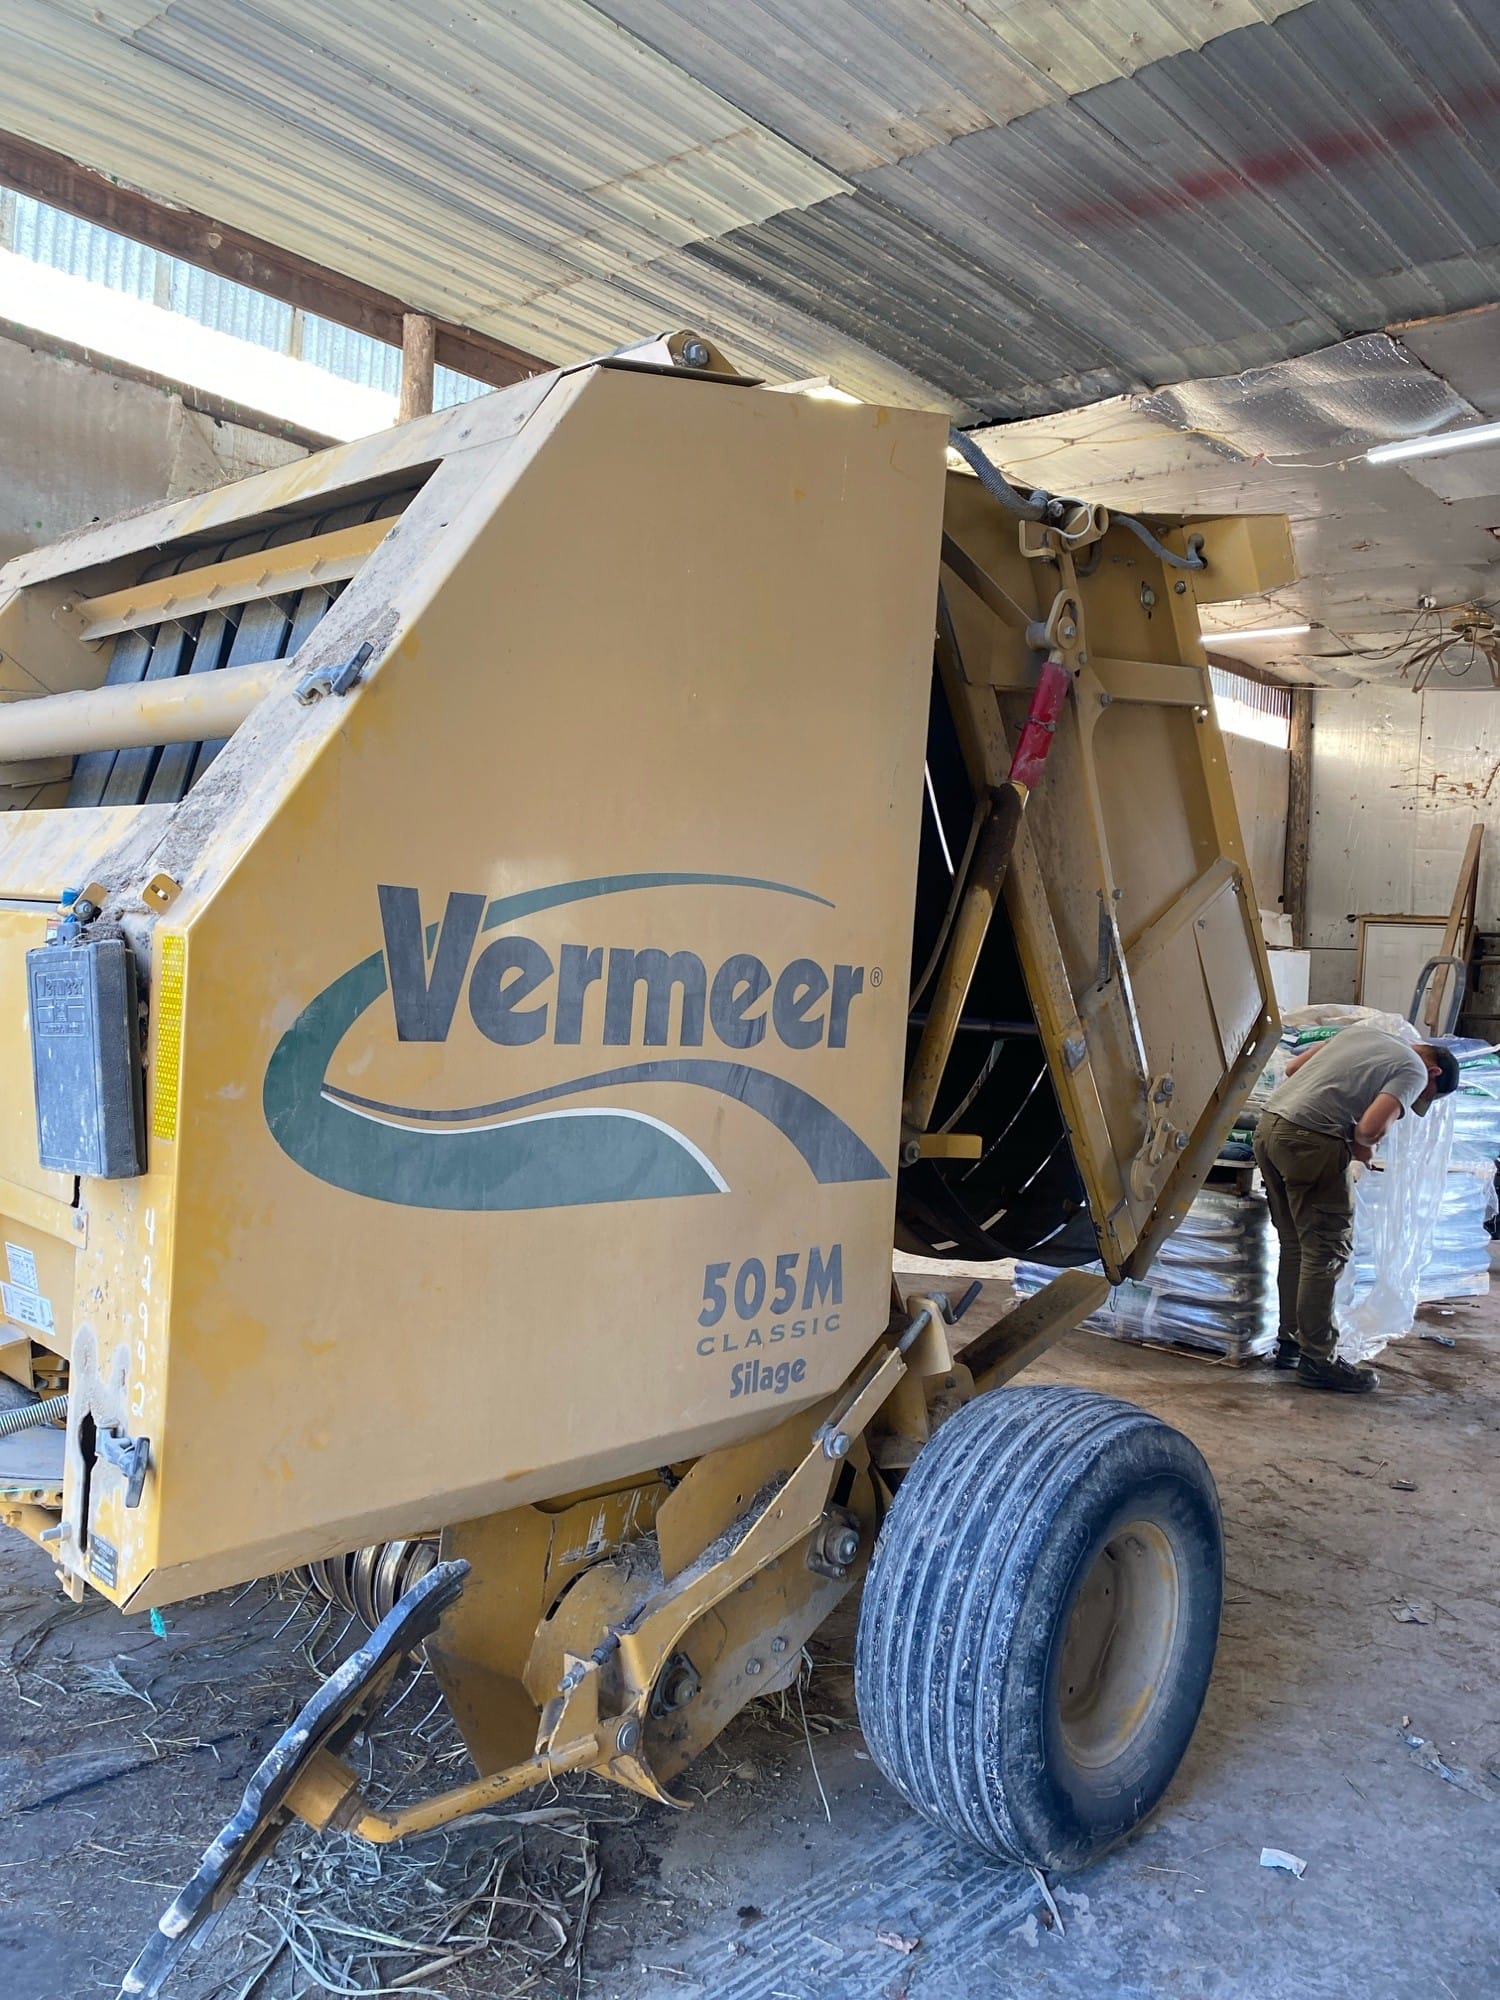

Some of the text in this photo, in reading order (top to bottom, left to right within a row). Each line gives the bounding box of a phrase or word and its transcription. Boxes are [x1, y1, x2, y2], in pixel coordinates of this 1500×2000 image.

[377, 884, 864, 1049] Vermeer
[697, 1243, 843, 1327] 505M
[696, 1314, 841, 1356] CLASSIC
[729, 1358, 807, 1398] Silage
